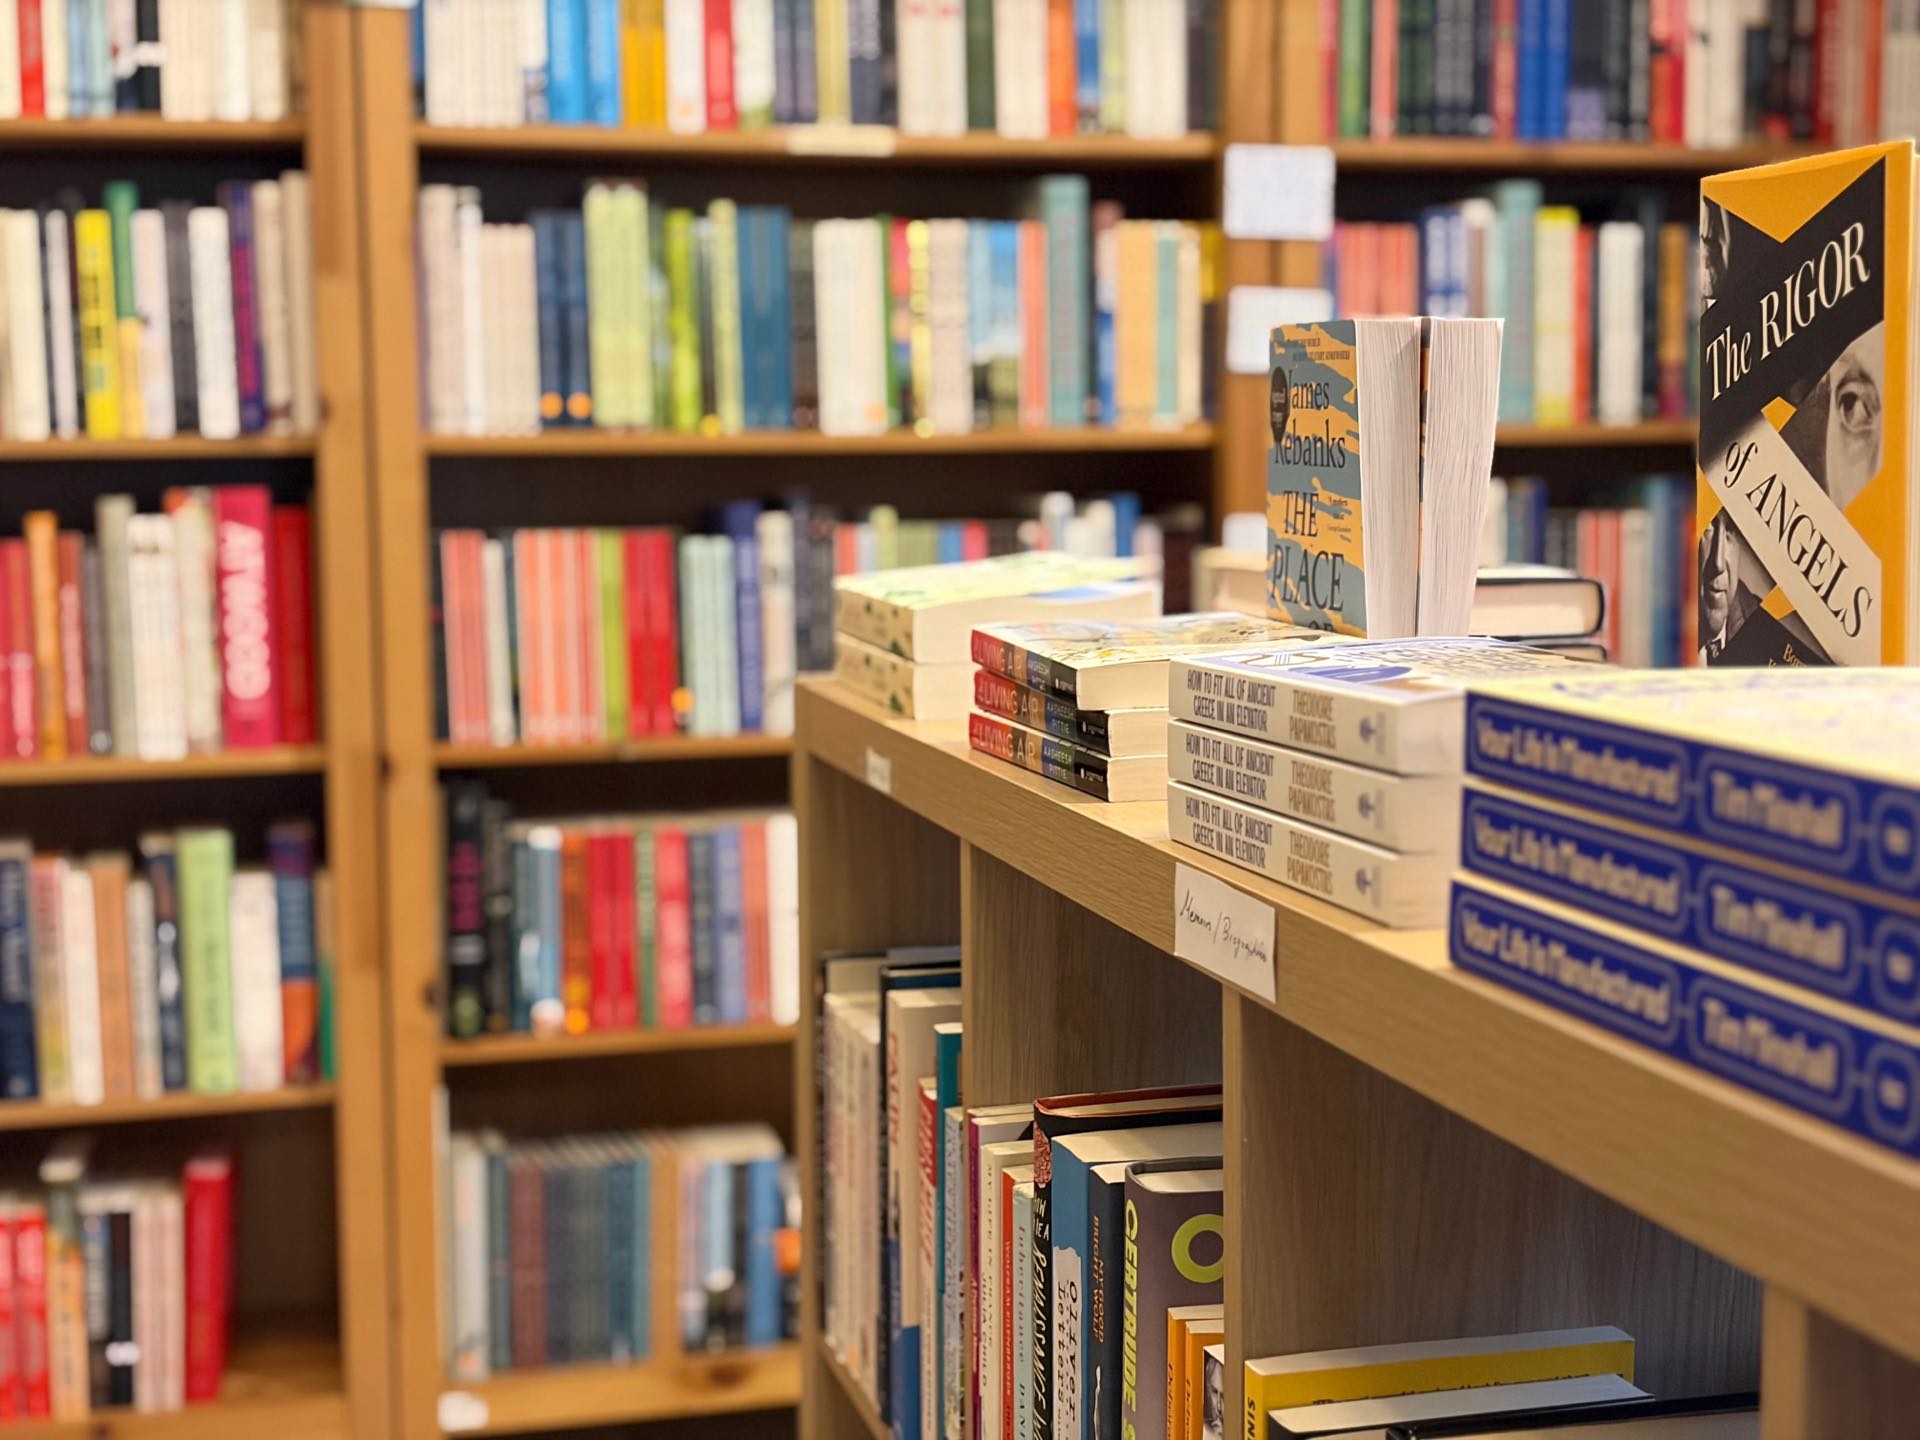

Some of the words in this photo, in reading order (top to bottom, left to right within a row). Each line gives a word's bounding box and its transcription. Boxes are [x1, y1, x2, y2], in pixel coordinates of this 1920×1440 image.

[1706, 326, 1752, 400] The
[1760, 222, 1870, 361] RIGOR
[1288, 369, 1330, 410] James
[1283, 490, 1319, 538] THE
[1724, 441, 1758, 488] of
[1745, 473, 1873, 638] ANGELS
[1270, 544, 1344, 612] PLACE
[984, 681, 1017, 715] LIVING
[1187, 669, 1202, 692] HOW
[1204, 672, 1212, 695] TO
[1213, 674, 1223, 697] FIT
[1224, 677, 1235, 699] ALL
[1237, 678, 1246, 700] OF
[1247, 681, 1276, 707] ANCIENT
[1193, 695, 1215, 720] GREECE
[1216, 700, 1225, 722] IN
[1226, 702, 1235, 724] AN
[1237, 704, 1268, 733] ELEVATOR
[979, 721, 1014, 758] LIVING
[1017, 738, 1035, 764] AIR
[1186, 733, 1200, 756] HOW
[1202, 737, 1211, 759] TO
[1212, 739, 1222, 761] FIT
[1223, 743, 1234, 766] ALL
[1235, 746, 1244, 768] OF
[1246, 749, 1274, 777] ANCIENT
[1192, 759, 1215, 785] GREECE
[1216, 765, 1223, 788] IN
[1225, 768, 1234, 791] AN
[1236, 771, 1267, 801] ELEVATOR
[1185, 796, 1200, 820] HOW
[1201, 801, 1210, 823] TO
[1211, 804, 1221, 827] FIT
[1222, 808, 1233, 831] ALL
[1234, 812, 1243, 835] OF
[1245, 815, 1273, 846] ANCIENT
[1192, 822, 1215, 850] GREECE
[1215, 831, 1223, 853] IN
[1225, 833, 1234, 857] AN
[1235, 838, 1266, 869] ELEVATOR
[1098, 1257, 1104, 1287] MY
[1033, 1241, 1049, 1411] RENAISSANCE
[1124, 1199, 1138, 1412] GERTRUDE
[1057, 1281, 1066, 1403] Letters
[1068, 1281, 1078, 1422] Oliver
[1247, 1396, 1256, 1440] SIN
